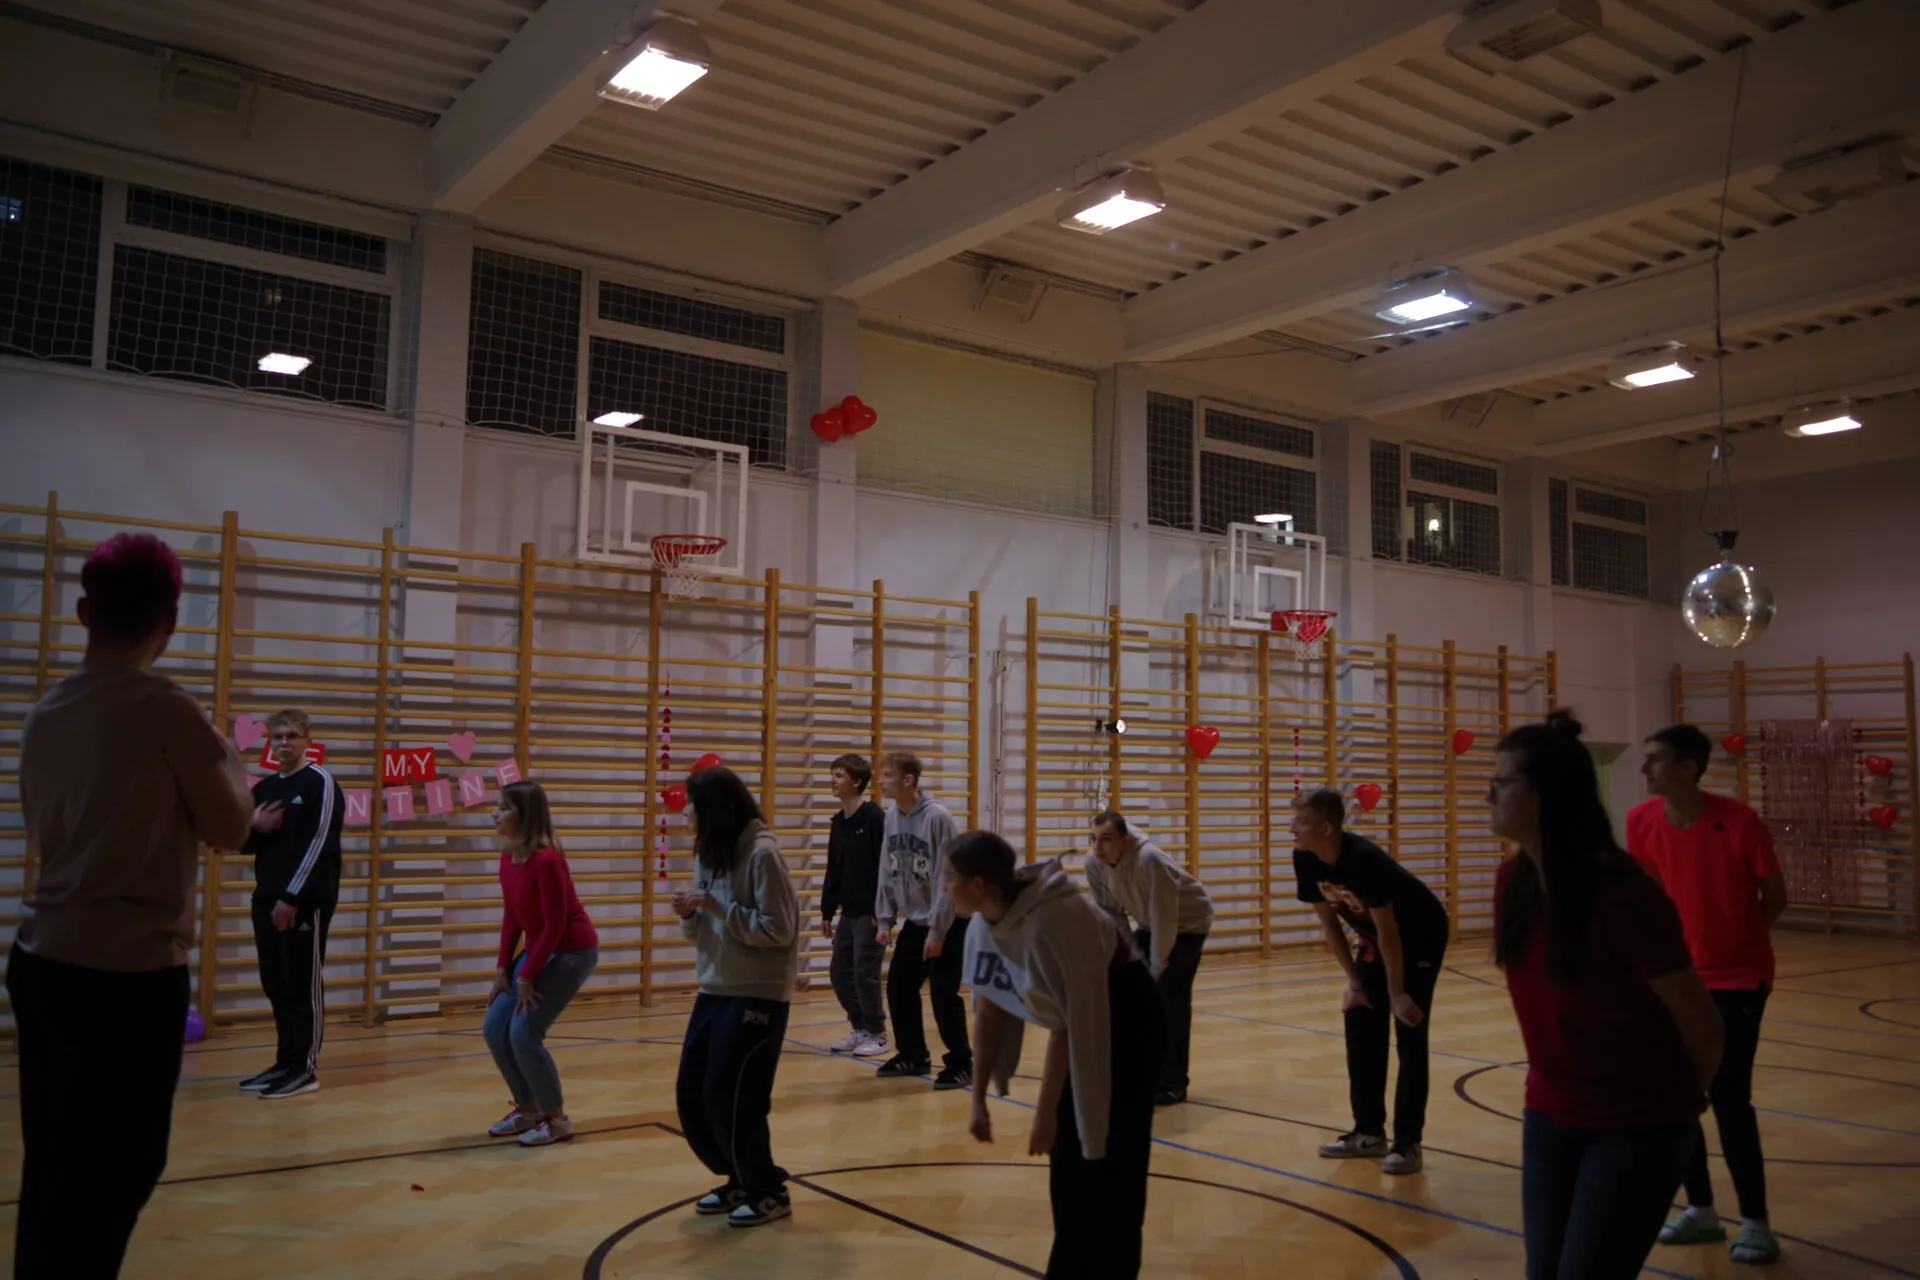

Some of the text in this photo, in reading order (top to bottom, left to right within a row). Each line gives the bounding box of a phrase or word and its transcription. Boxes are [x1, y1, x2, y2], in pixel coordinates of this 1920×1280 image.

[385, 752, 432, 776] MY
[245, 764, 516, 818] NTINE
[973, 951, 1024, 1004] US
